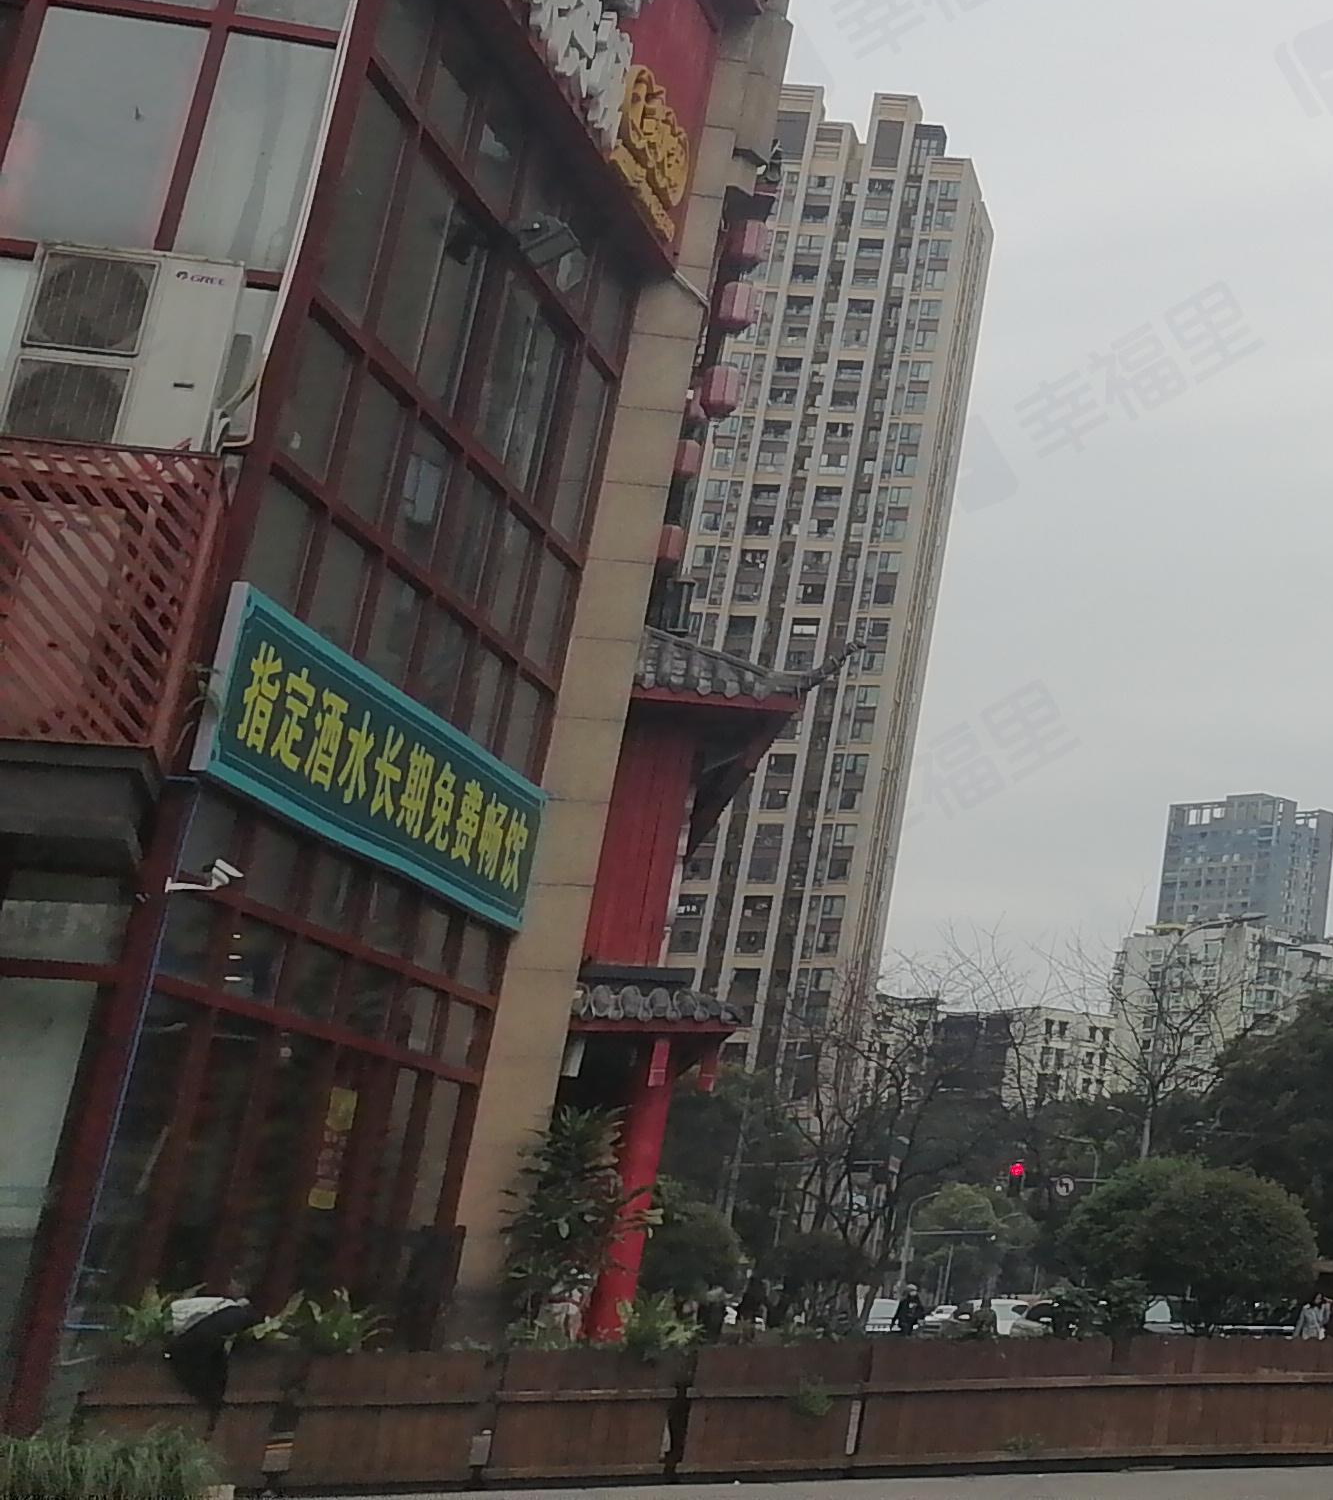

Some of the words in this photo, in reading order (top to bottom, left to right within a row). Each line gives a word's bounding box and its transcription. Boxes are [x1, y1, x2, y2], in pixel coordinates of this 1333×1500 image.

[236, 641, 529, 893] 指定酒水长期免费畅饮
